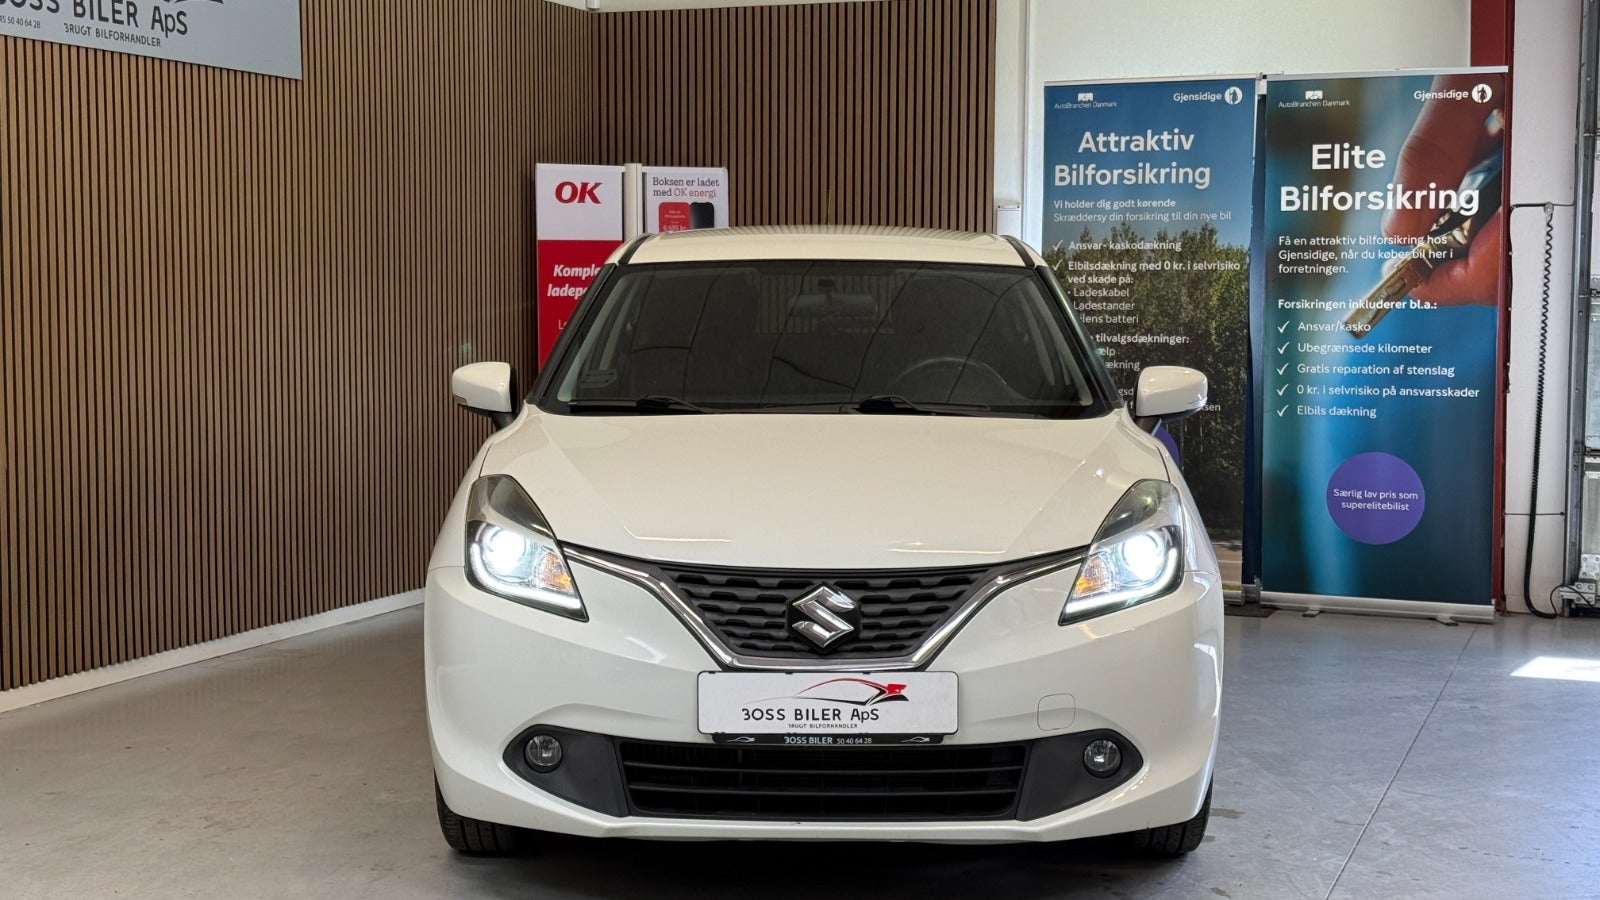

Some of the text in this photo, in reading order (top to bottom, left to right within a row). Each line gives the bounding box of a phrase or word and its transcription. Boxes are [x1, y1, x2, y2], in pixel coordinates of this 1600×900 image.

[7, 16, 15, 24] 50
[16, 17, 24, 26] 40
[24, 18, 32, 28] 64
[33, 20, 41, 29] 28
[73, 0, 139, 28] BILER
[150, 5, 188, 39] ApS
[95, 27, 162, 48] BILFORHANDLER
[1173, 92, 1222, 104] Gjensidige
[1414, 90, 1469, 104] Gjensidige
[1078, 128, 1195, 153] Attraktiv
[1312, 142, 1386, 170] Elite
[653, 176, 684, 186] Boksen
[697, 178, 720, 186] ladet
[1054, 161, 1211, 190] Bilforsikring
[555, 181, 603, 204] OK
[653, 188, 716, 199] med OK energi
[1053, 198, 1176, 210] Vi holder dig godt kørende
[1280, 182, 1480, 217] Bilforsikring
[1053, 211, 1232, 223] Skræddersy din forsikring til din nye bil
[1068, 241, 1182, 252] Ansvar- kaskodækning
[1278, 235, 1448, 248] Få en attraktiv bilforsikring hos
[1278, 249, 1454, 262] Gjensidige, når du køber bil her i
[1068, 261, 1240, 272] Elbilsdækning med 0 kr. i selvrisiko
[1278, 264, 1349, 276] forretningen.
[1068, 275, 1134, 286] ved skade på:
[1074, 288, 1130, 297] Ladeskabel
[1074, 301, 1135, 310] Ladestander
[1278, 299, 1438, 310] Forsikringen inkluderer bl.a.:
[1105, 314, 1140, 324] batteri
[1298, 322, 1372, 332] Ansvar/kasko
[1096, 334, 1190, 345] tilvalgsdækninger:
[1298, 342, 1432, 354] Ubegrænsede kilometer
[1297, 364, 1456, 378] Gratis reparation af stenslag
[1297, 384, 1480, 398] 0 kr. i selvrisiko på ansvarsskader
[1297, 406, 1377, 418] Elbils dækning
[1333, 488, 1418, 500] Særlig lav pris som
[1341, 501, 1410, 511] superelitebilist
[794, 708, 842, 721] BILER
[850, 708, 880, 723] ApS
[809, 736, 833, 744] BILER
